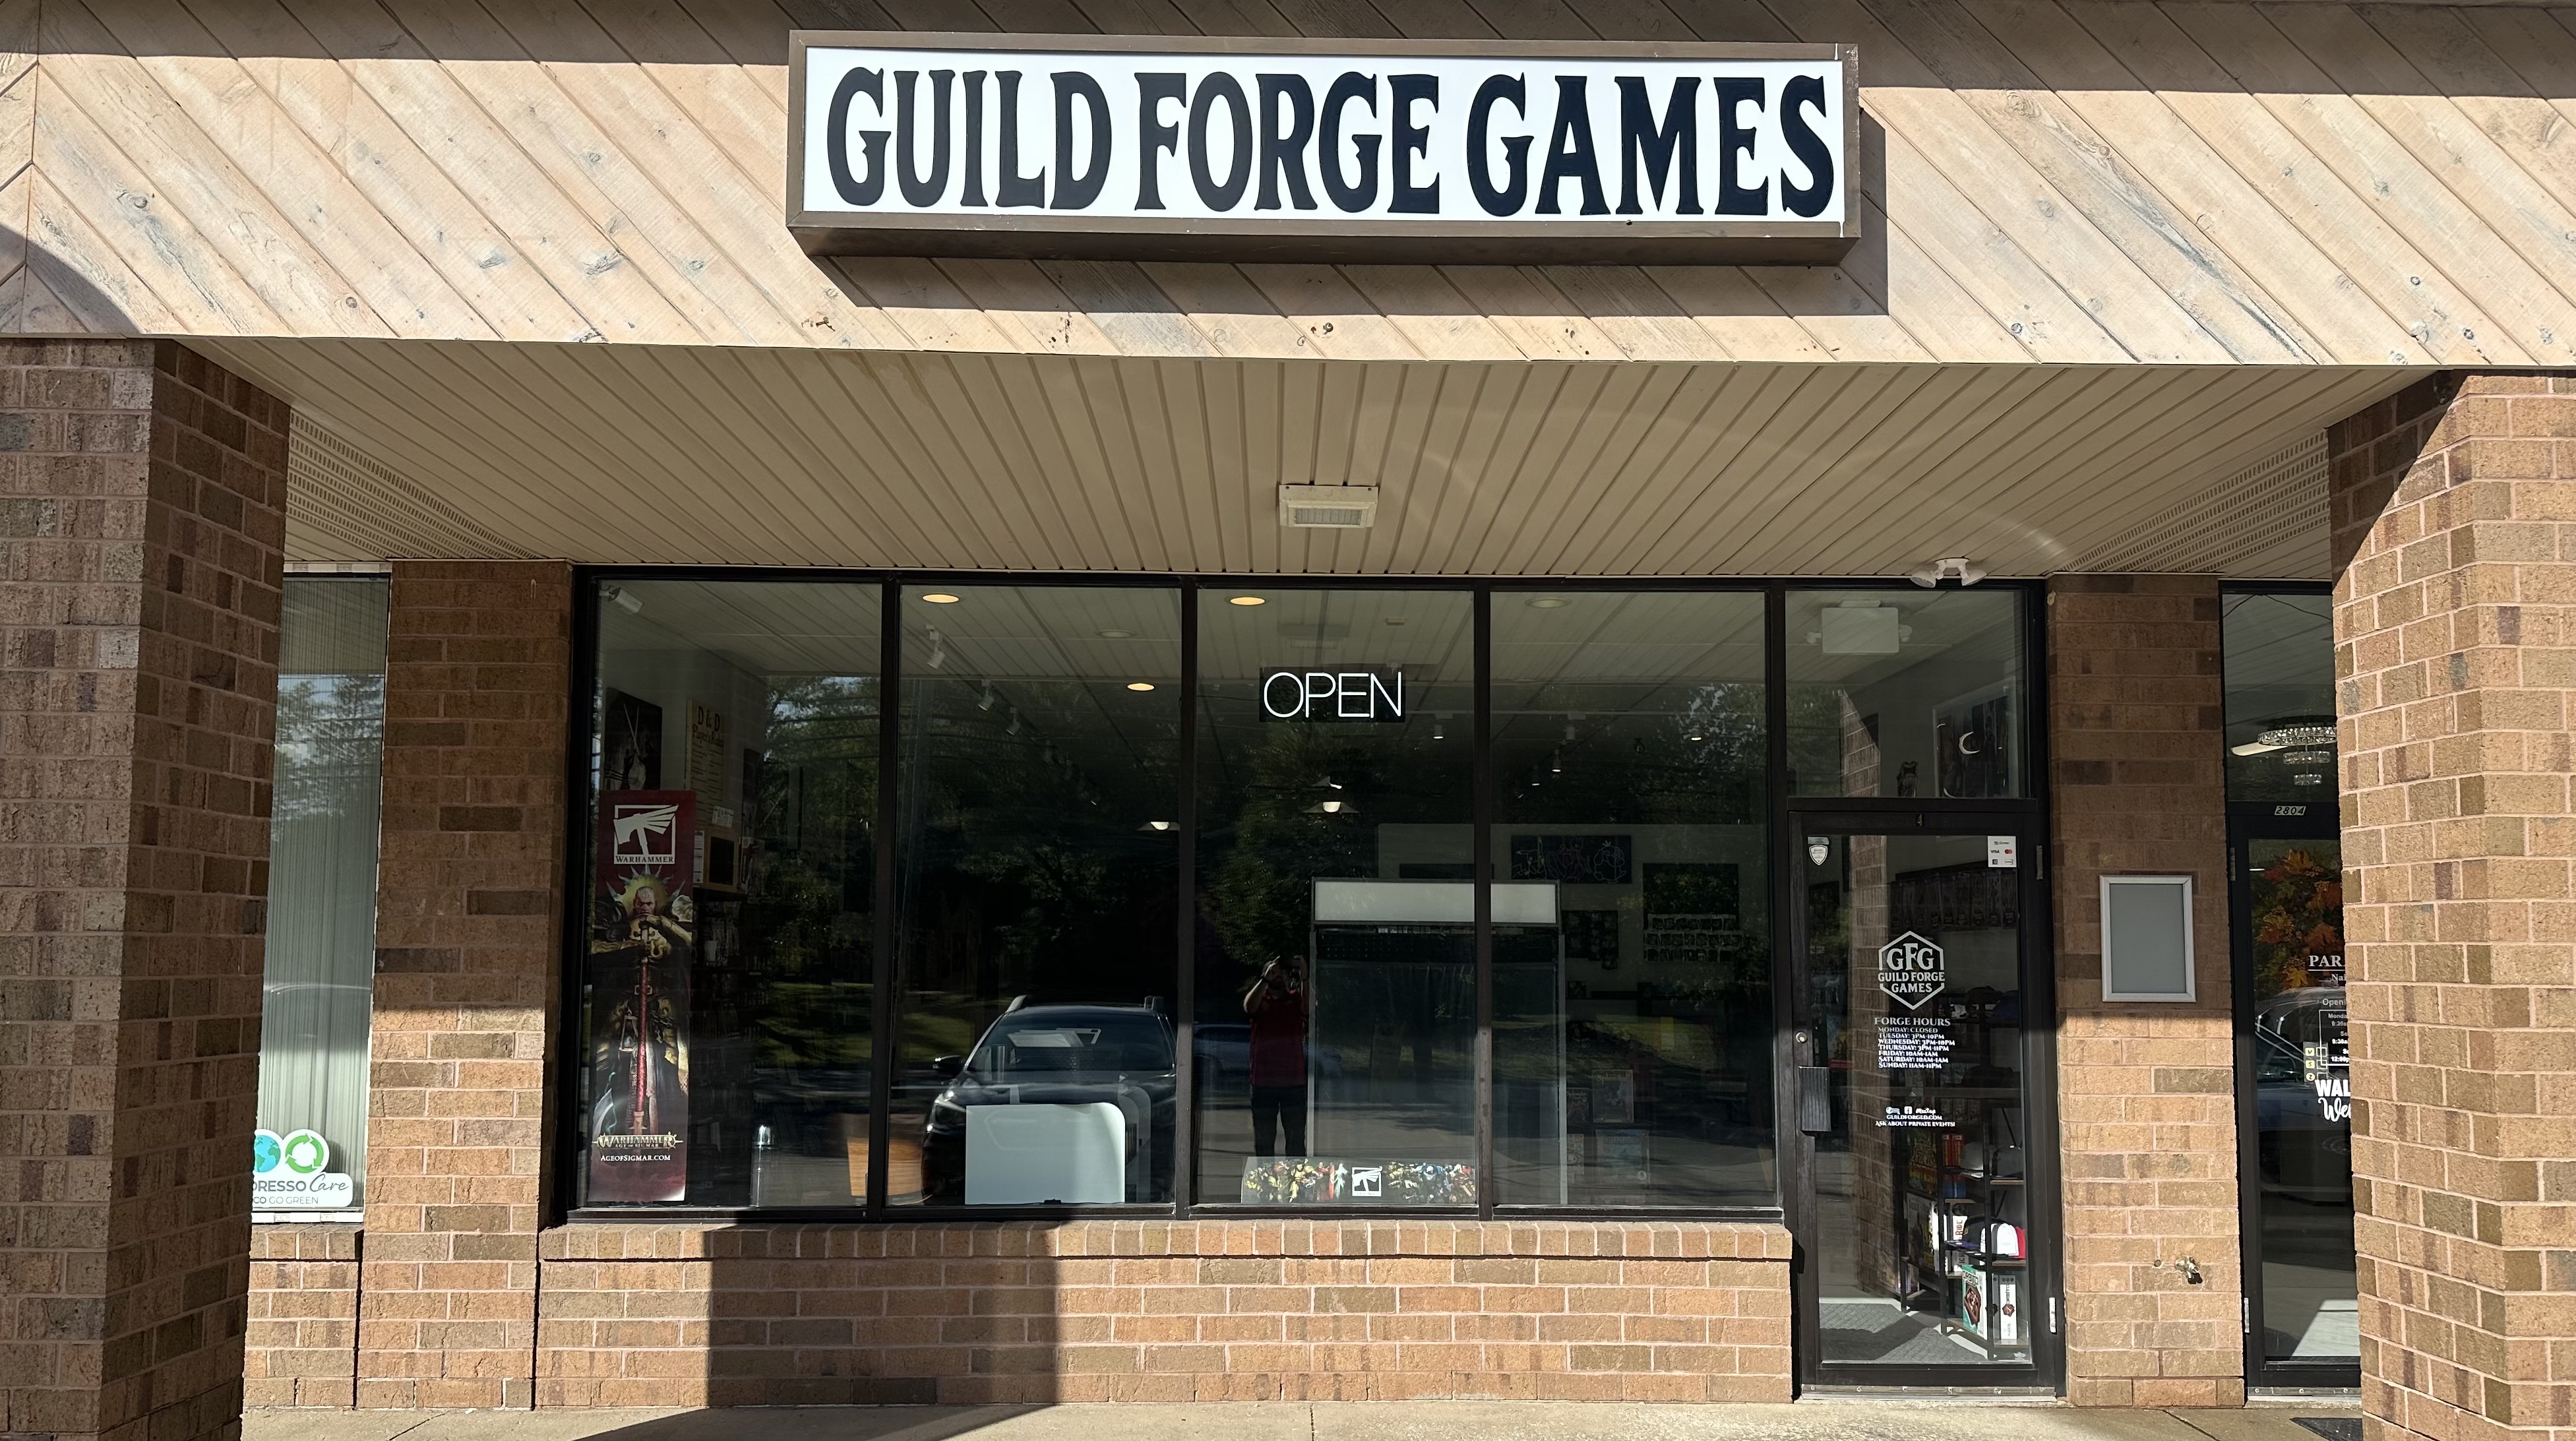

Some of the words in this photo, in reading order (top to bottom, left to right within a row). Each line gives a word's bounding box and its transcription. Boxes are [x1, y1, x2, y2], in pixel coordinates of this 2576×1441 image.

[827, 67, 1112, 208] GUILD
[1134, 73, 1440, 214] FORGE
[1467, 74, 1833, 216] GAMES
[1264, 671, 1401, 718] OPEN
[1917, 813, 1923, 826] 4
[1887, 943, 1934, 971] GFG
[2309, 955, 2345, 967] PAR
[1878, 972, 1909, 982] GUILD
[1911, 971, 1945, 981] FORGE
[1891, 983, 1932, 993] GAMES
[1913, 1018, 1951, 1026] HOURS
[309, 1174, 350, 1192] Care
